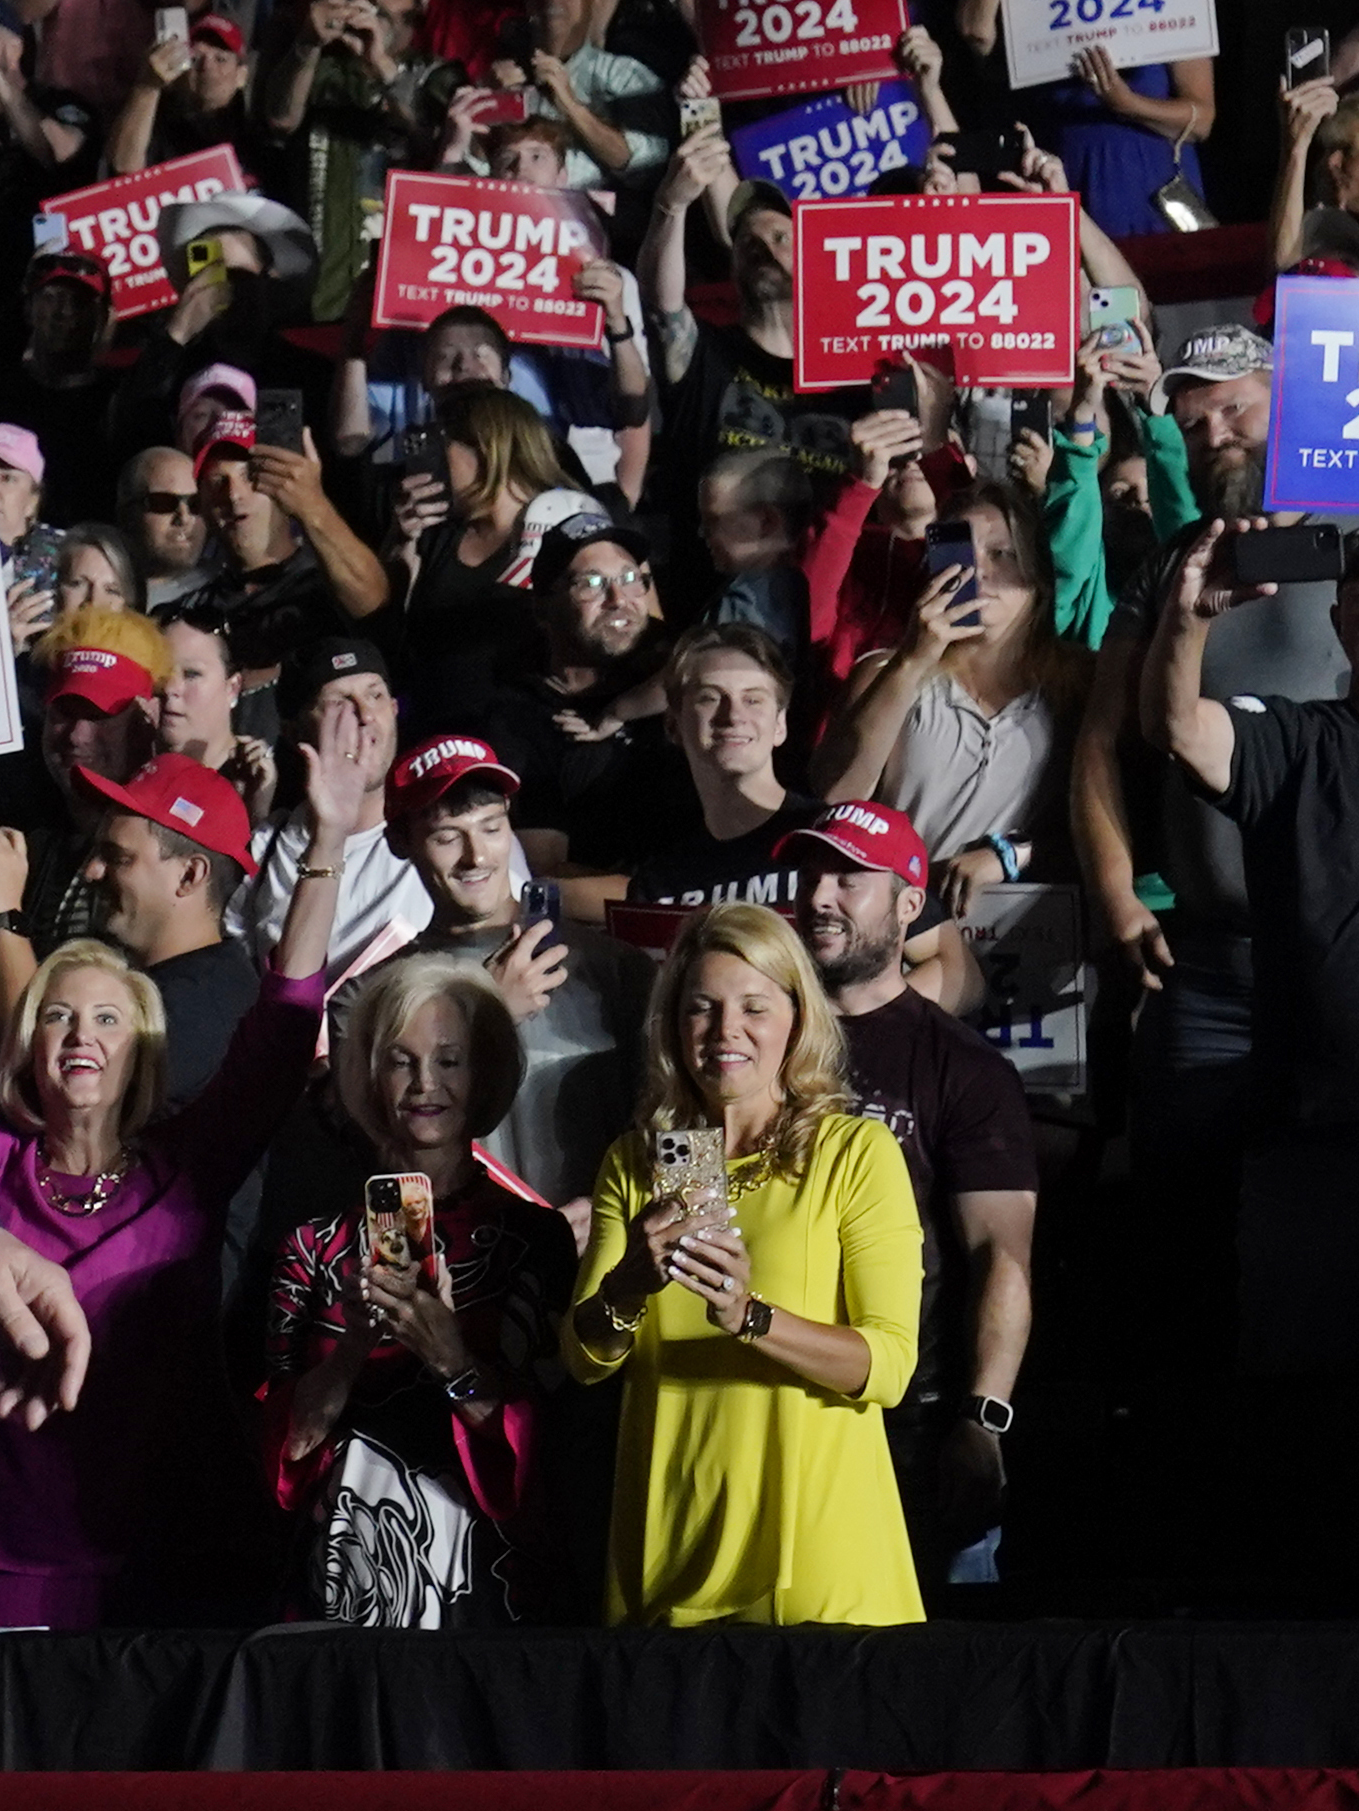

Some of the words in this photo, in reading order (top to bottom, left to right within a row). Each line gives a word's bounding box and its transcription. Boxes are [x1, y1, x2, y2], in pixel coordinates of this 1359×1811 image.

[734, 0, 858, 47] 2024
[1066, 28, 1117, 44] TRUMP
[754, 46, 808, 66] TRUMP
[813, 42, 835, 57] TO
[839, 34, 892, 55] 88022
[758, 101, 919, 181] TRUMP
[792, 139, 909, 199] 2024
[408, 203, 589, 256] TRUMP
[101, 233, 161, 277] 20
[428, 245, 560, 293] 2024
[823, 232, 1051, 282] TRUMP
[397, 283, 439, 301] TEXT
[443, 288, 504, 307] TRUMP
[508, 295, 530, 311] TO
[533, 297, 587, 317] 88022
[855, 279, 1019, 328] 2024
[820, 336, 871, 353] TEXT
[877, 333, 950, 350] TRUMP
[956, 332, 984, 349] TO
[990, 332, 1056, 350] 88022
[1299, 448, 1358, 469] TEXT
[408, 739, 487, 778] TRUMP
[824, 804, 890, 835] UMP
